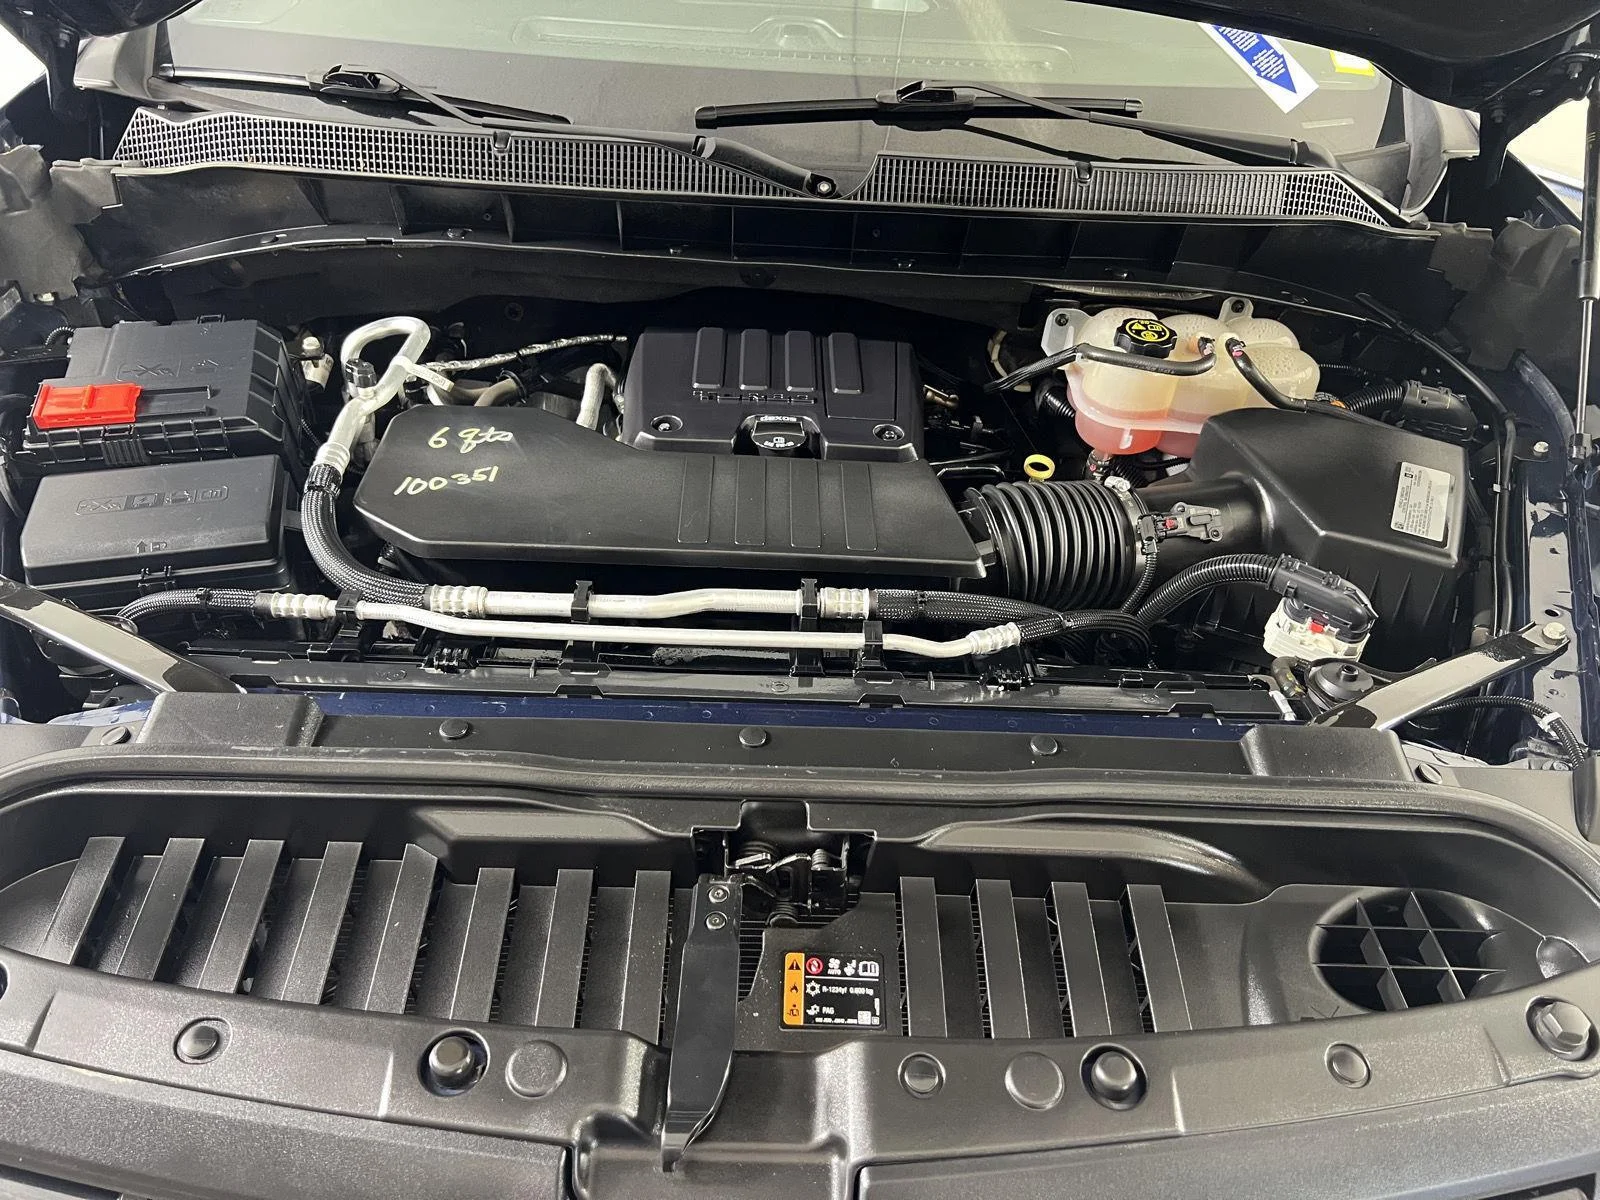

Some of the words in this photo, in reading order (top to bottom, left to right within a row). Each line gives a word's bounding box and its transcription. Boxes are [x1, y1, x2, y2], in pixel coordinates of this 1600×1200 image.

[428, 426, 450, 448] 6
[393, 465, 499, 495] 100351
[822, 1006, 835, 1015] PAG
